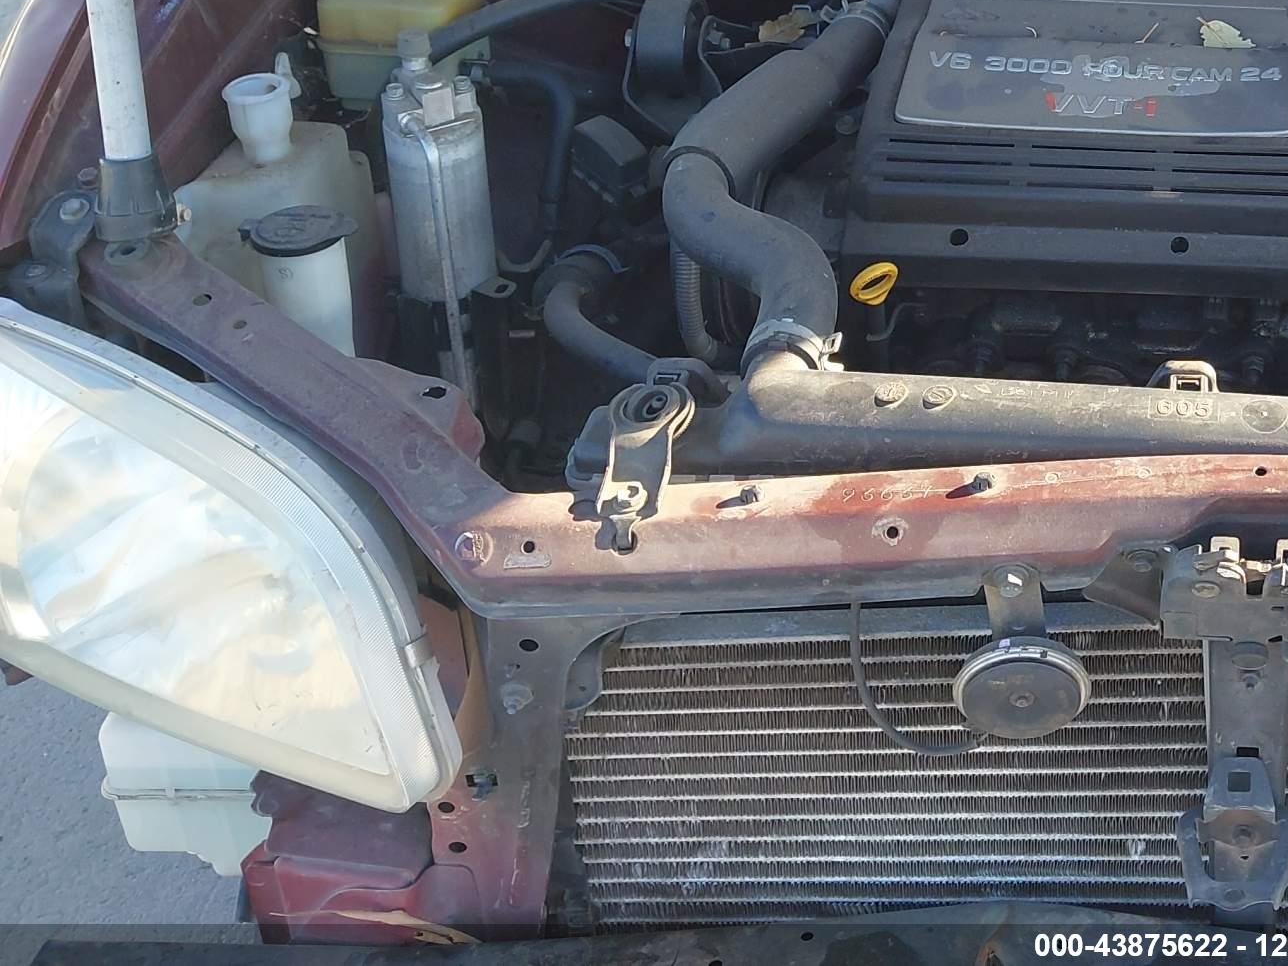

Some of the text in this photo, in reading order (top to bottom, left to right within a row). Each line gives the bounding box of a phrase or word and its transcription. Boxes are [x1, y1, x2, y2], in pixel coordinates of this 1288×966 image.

[929, 50, 1283, 82] V6 3000 FOUR CAM 24
[1156, 400, 1210, 418] 605
